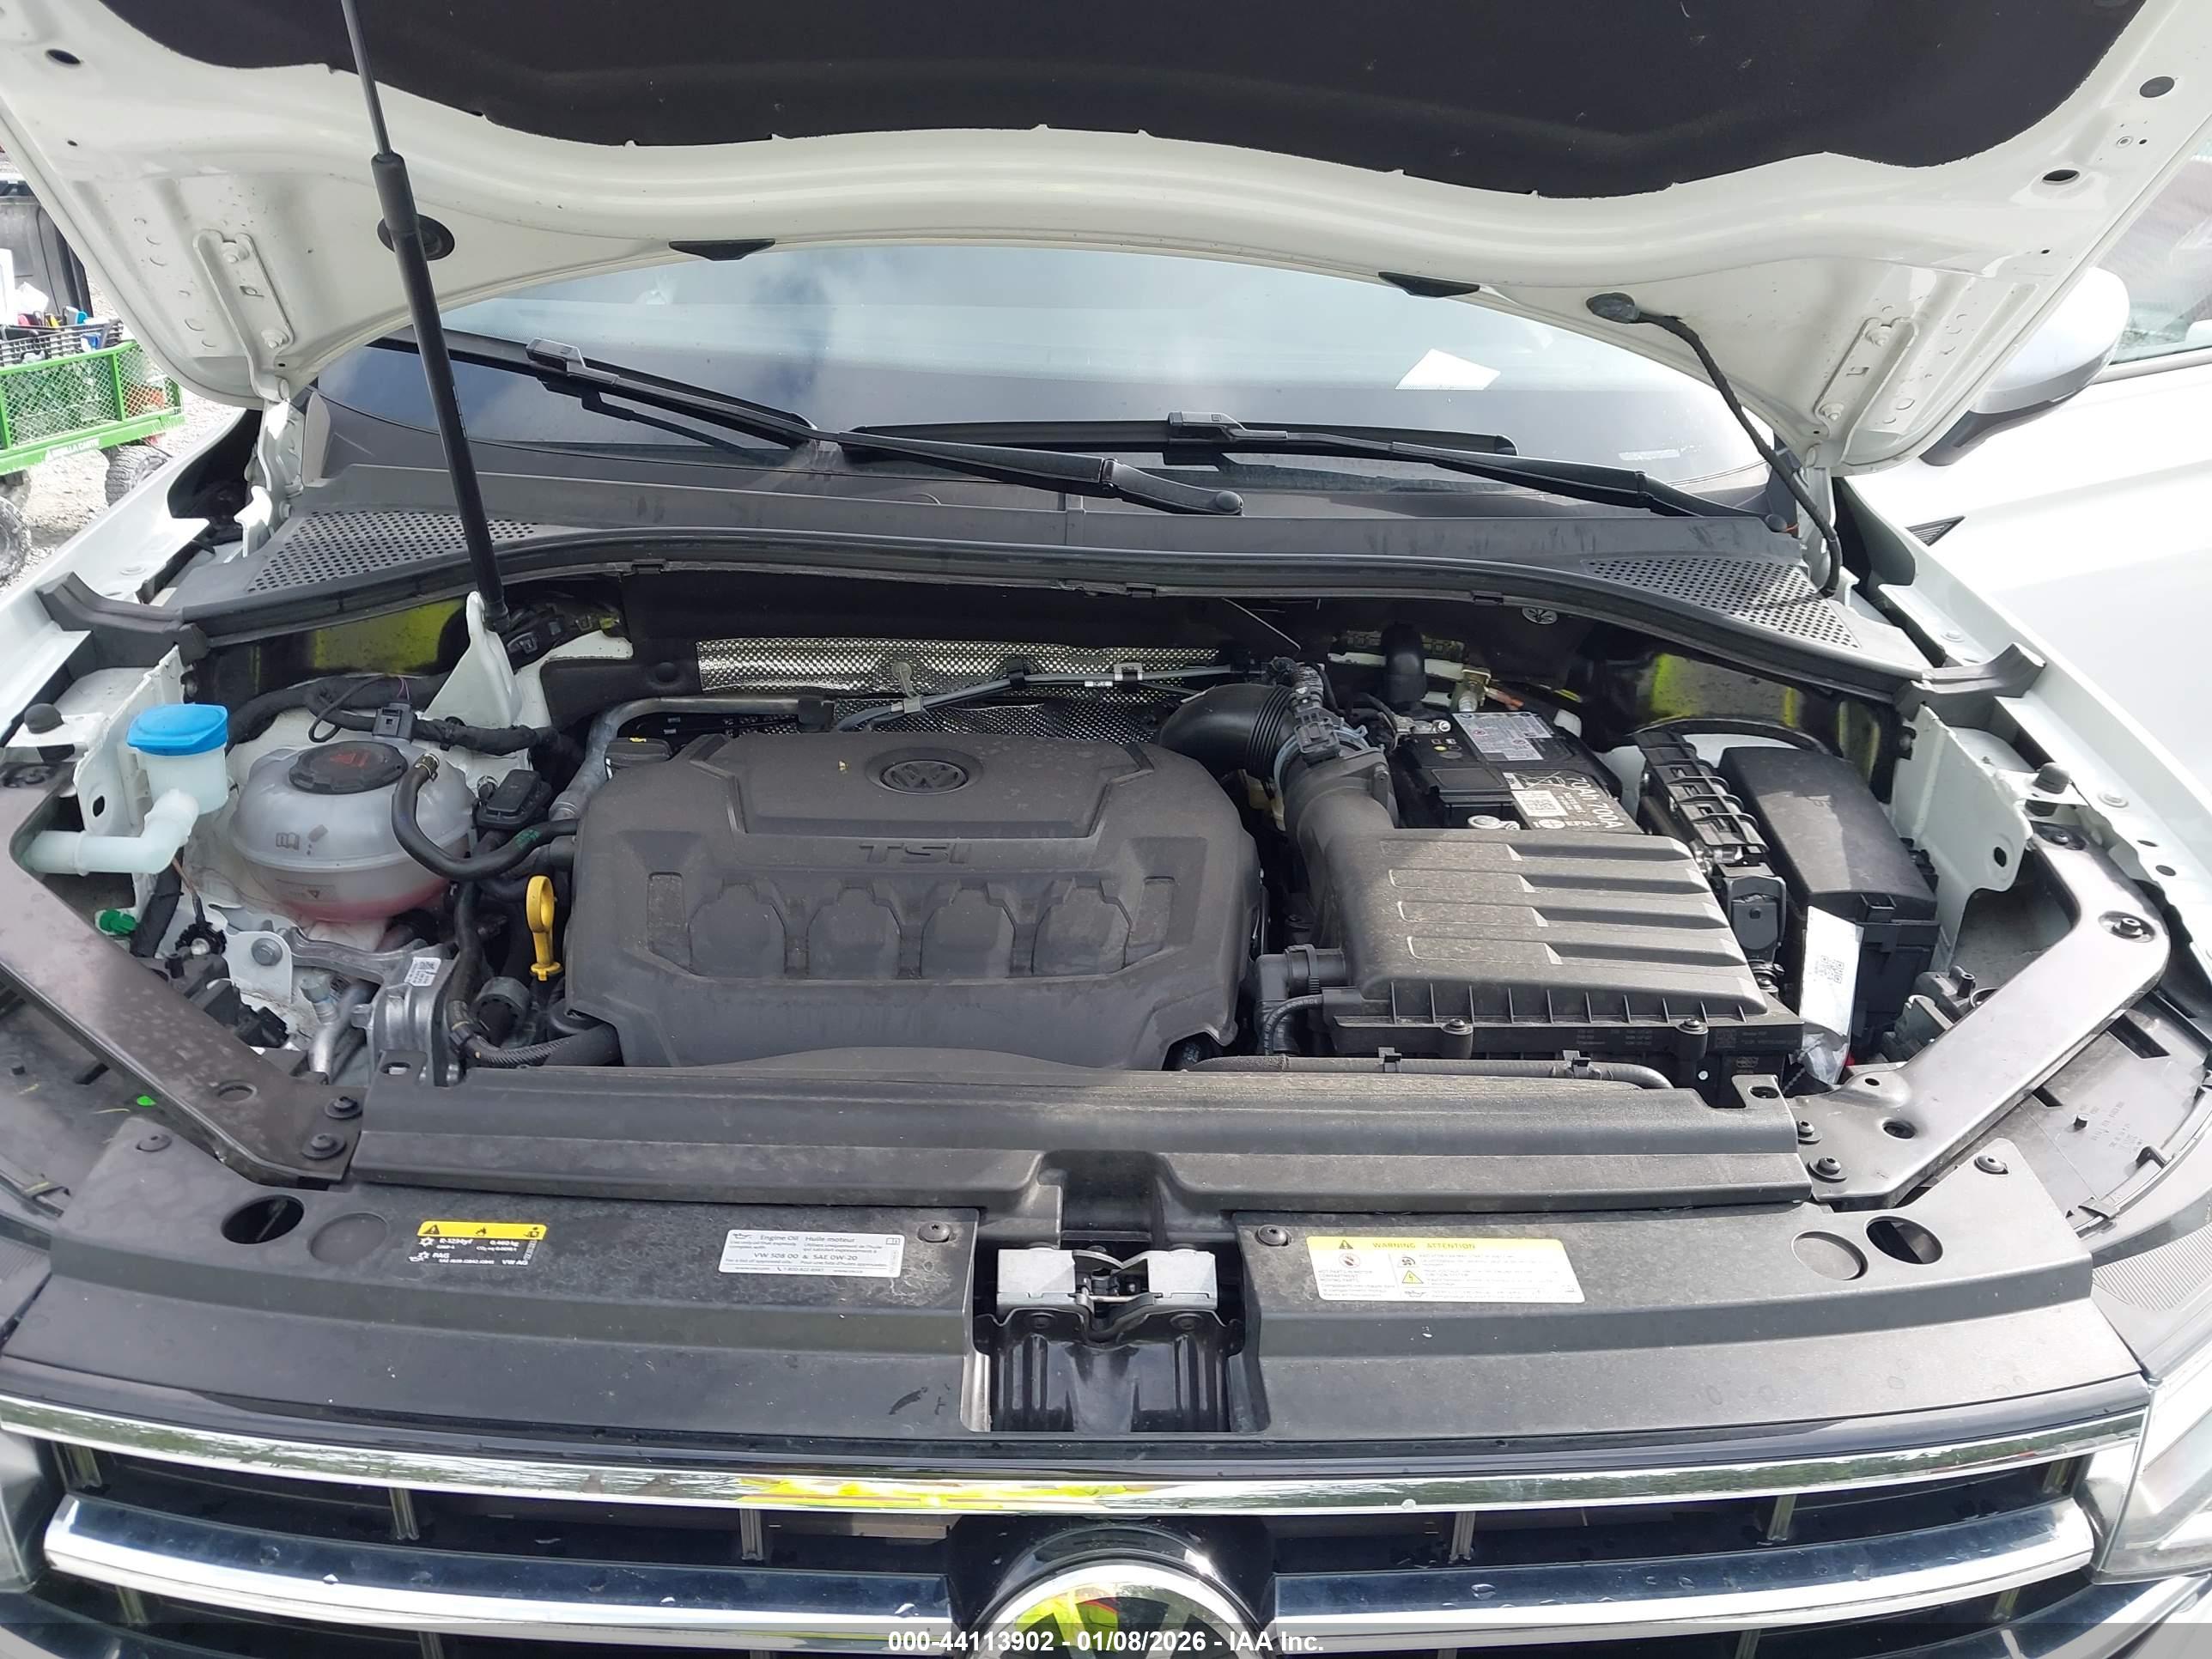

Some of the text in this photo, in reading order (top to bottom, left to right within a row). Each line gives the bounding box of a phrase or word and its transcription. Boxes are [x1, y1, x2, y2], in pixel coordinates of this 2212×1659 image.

[1566, 776, 1599, 800] 70Ah
[1589, 803, 1625, 829] 700A
[859, 842, 971, 865] TSI
